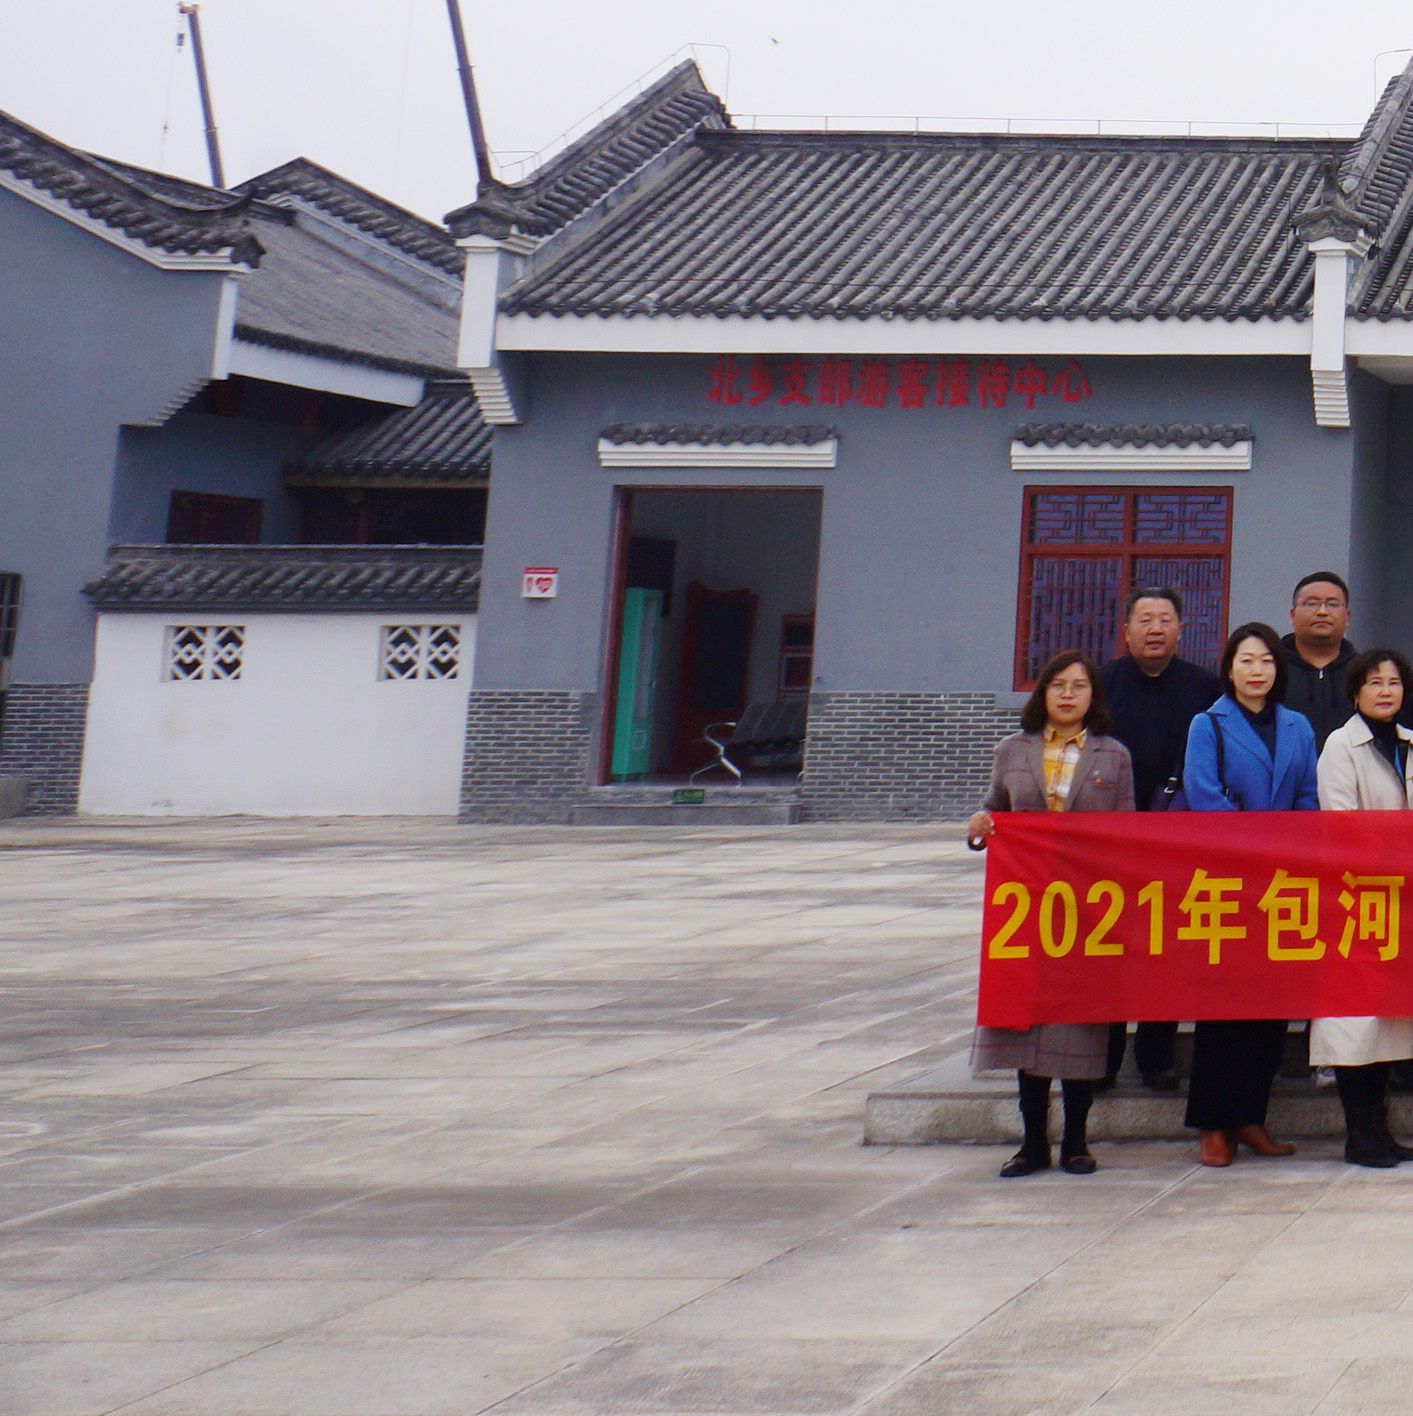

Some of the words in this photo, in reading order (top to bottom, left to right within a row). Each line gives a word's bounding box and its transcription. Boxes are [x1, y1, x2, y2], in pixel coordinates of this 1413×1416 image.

[706, 357, 1092, 410] 北乡支部游客接待中心
